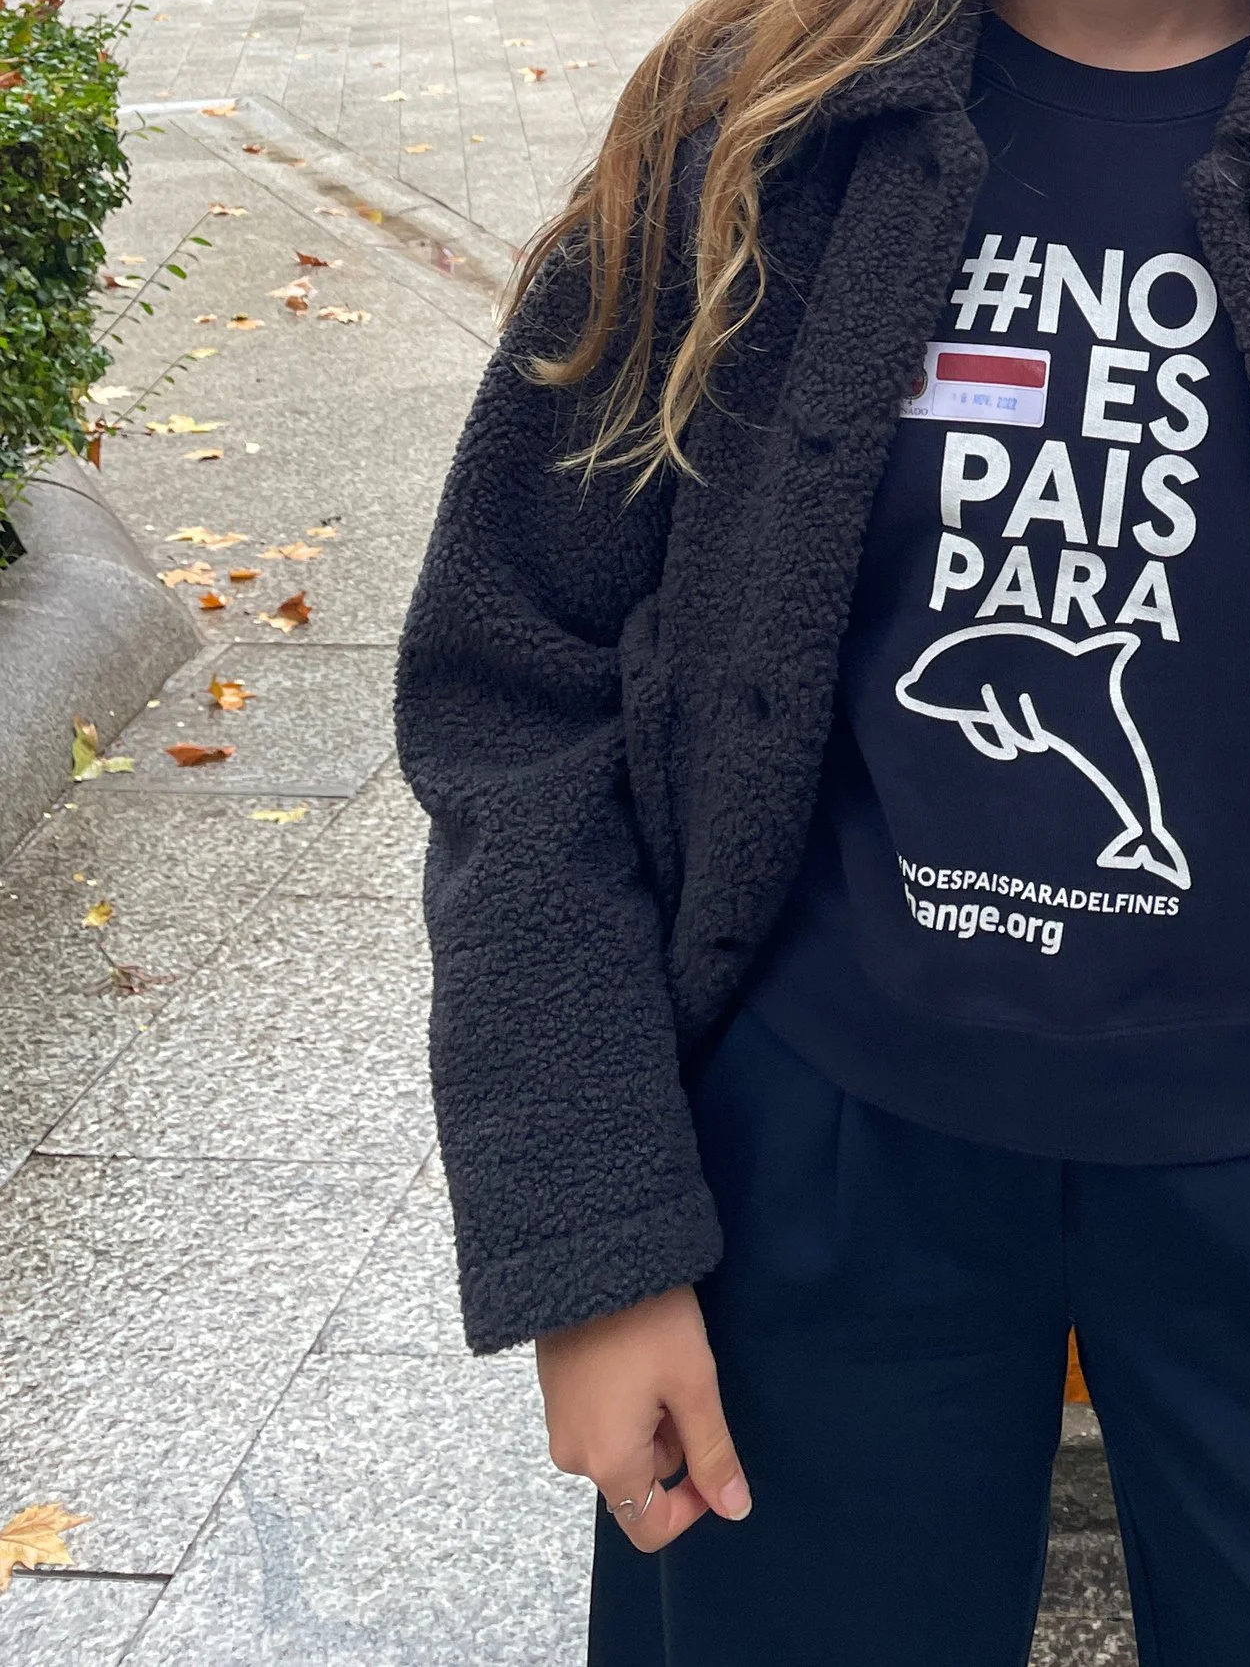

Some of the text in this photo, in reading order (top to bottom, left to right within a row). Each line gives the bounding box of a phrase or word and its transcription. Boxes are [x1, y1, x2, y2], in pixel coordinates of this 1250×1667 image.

[950, 234, 1218, 349] #NO
[1081, 344, 1211, 452] ES
[940, 431, 1200, 557] PAIS
[928, 531, 1181, 642] PARA
[898, 854, 1180, 916] NOESPAISPARADELFINES
[904, 882, 1064, 955] hange.org
